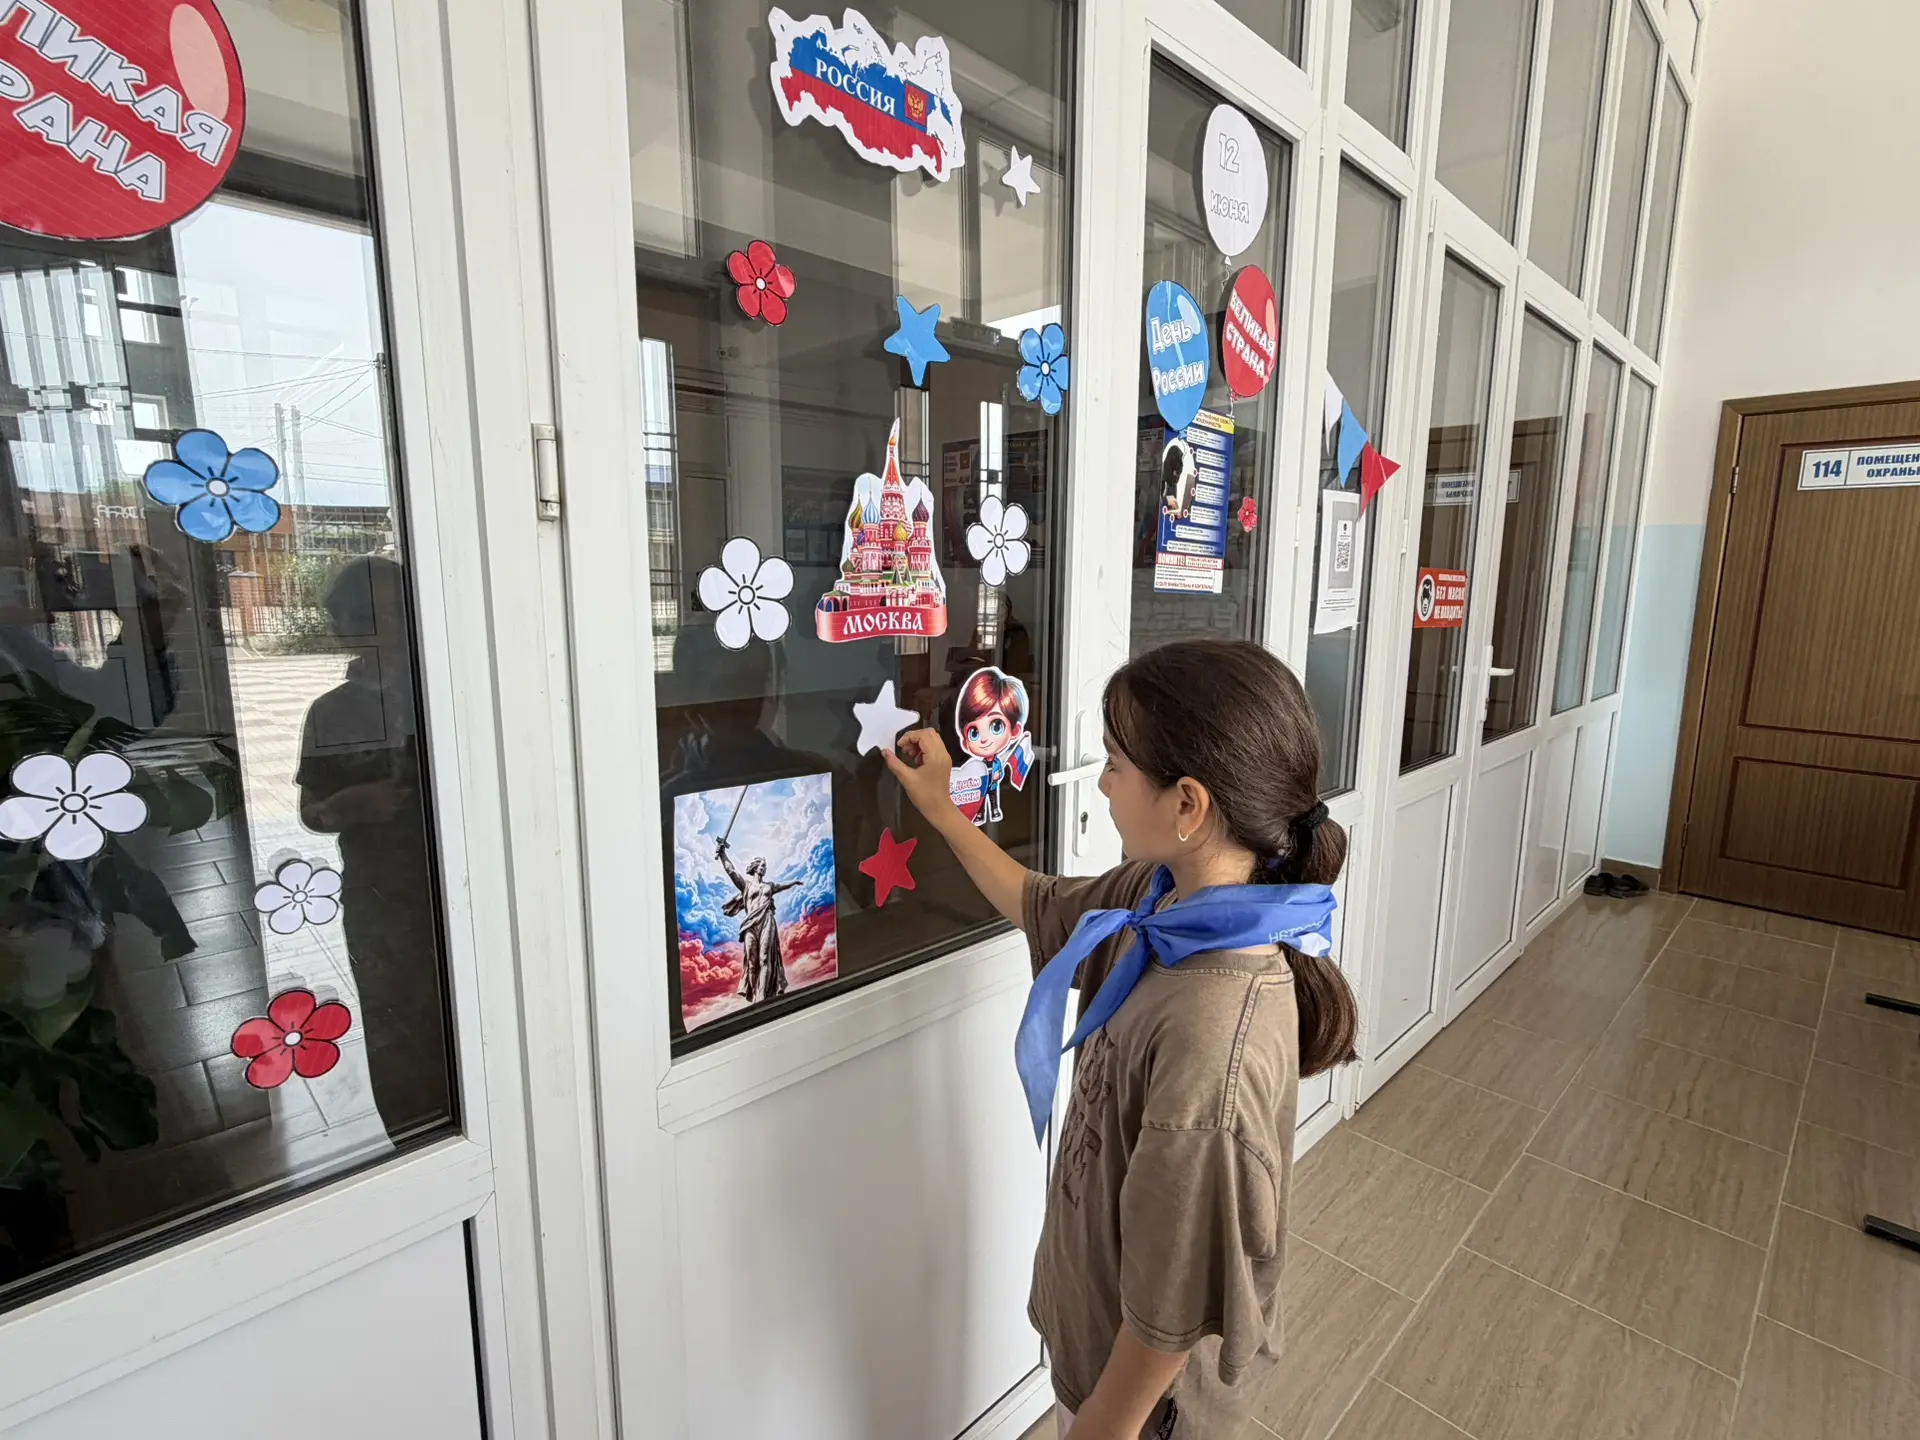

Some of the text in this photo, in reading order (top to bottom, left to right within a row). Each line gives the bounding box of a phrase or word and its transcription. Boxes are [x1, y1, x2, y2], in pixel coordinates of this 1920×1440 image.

[815, 57, 896, 117] РОССИЯ
[1219, 132, 1240, 174] 12
[1151, 317, 1193, 355] День
[1228, 288, 1277, 360] ВЕЛИКАЯ
[1225, 320, 1266, 378] СТРАНА
[1151, 360, 1205, 400] России
[1812, 459, 1843, 478] 114
[843, 611, 924, 635] МОСКВА
